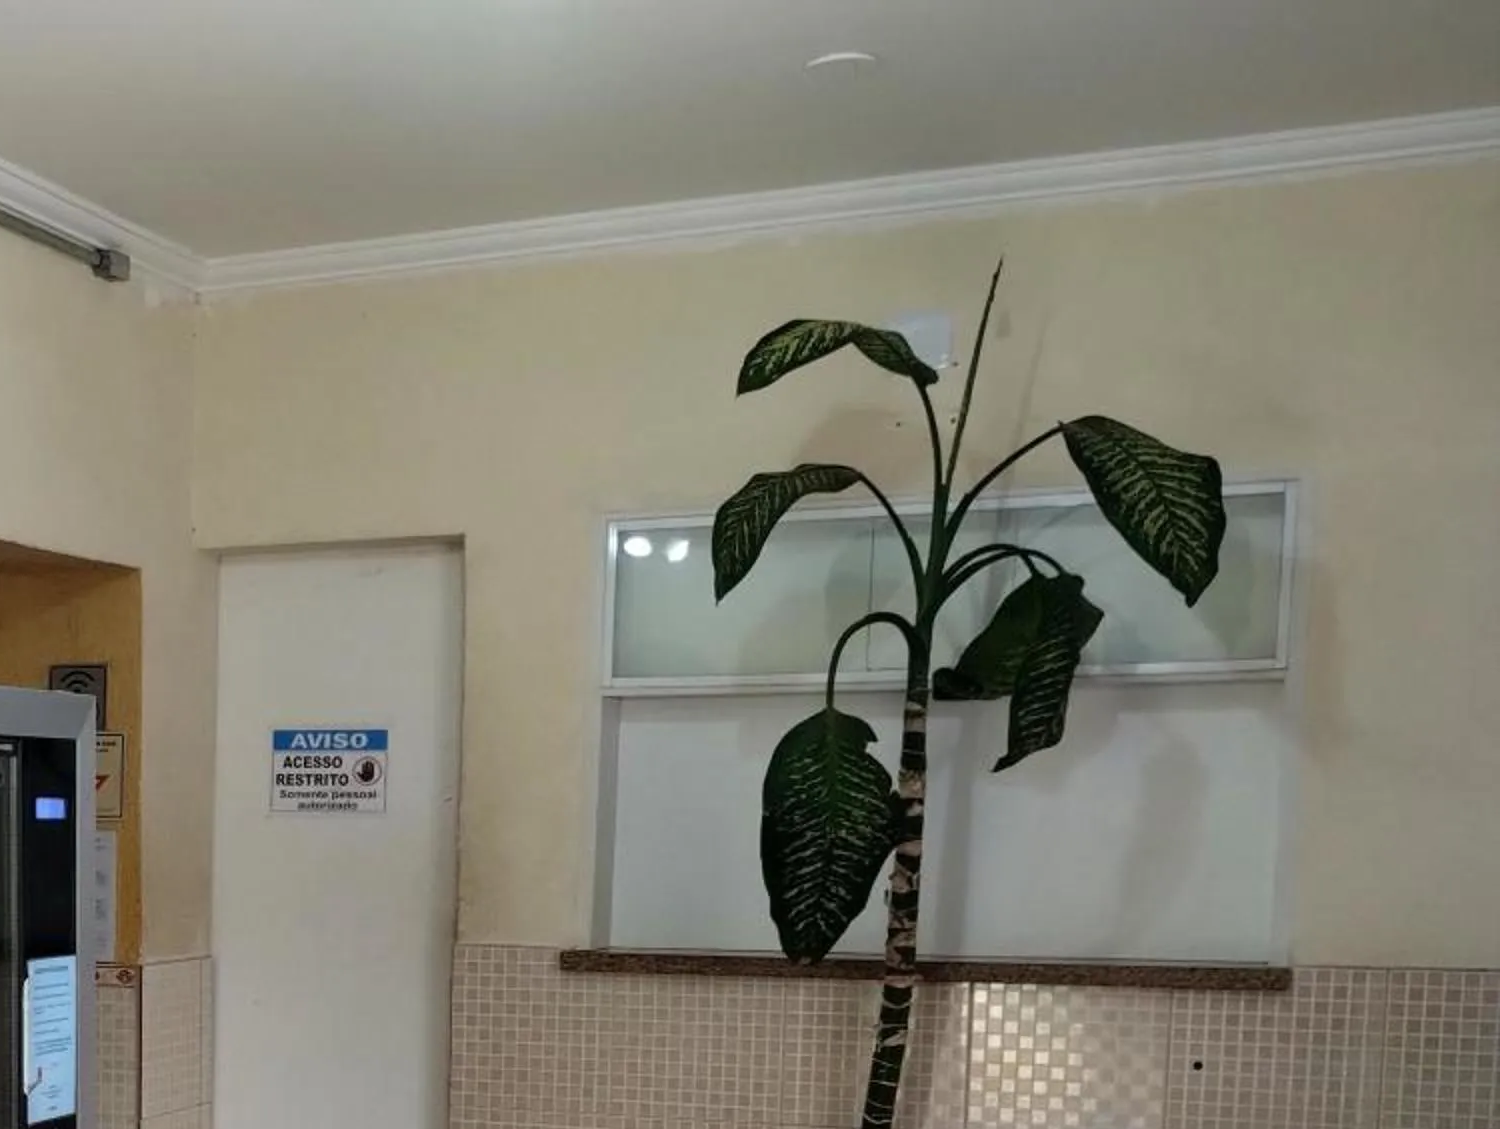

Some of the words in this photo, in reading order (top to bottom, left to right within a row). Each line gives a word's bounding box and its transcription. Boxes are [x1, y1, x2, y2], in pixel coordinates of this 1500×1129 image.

[291, 733, 369, 749] AVISO
[283, 755, 343, 769] ACESSO
[275, 773, 349, 787] RESTRITO
